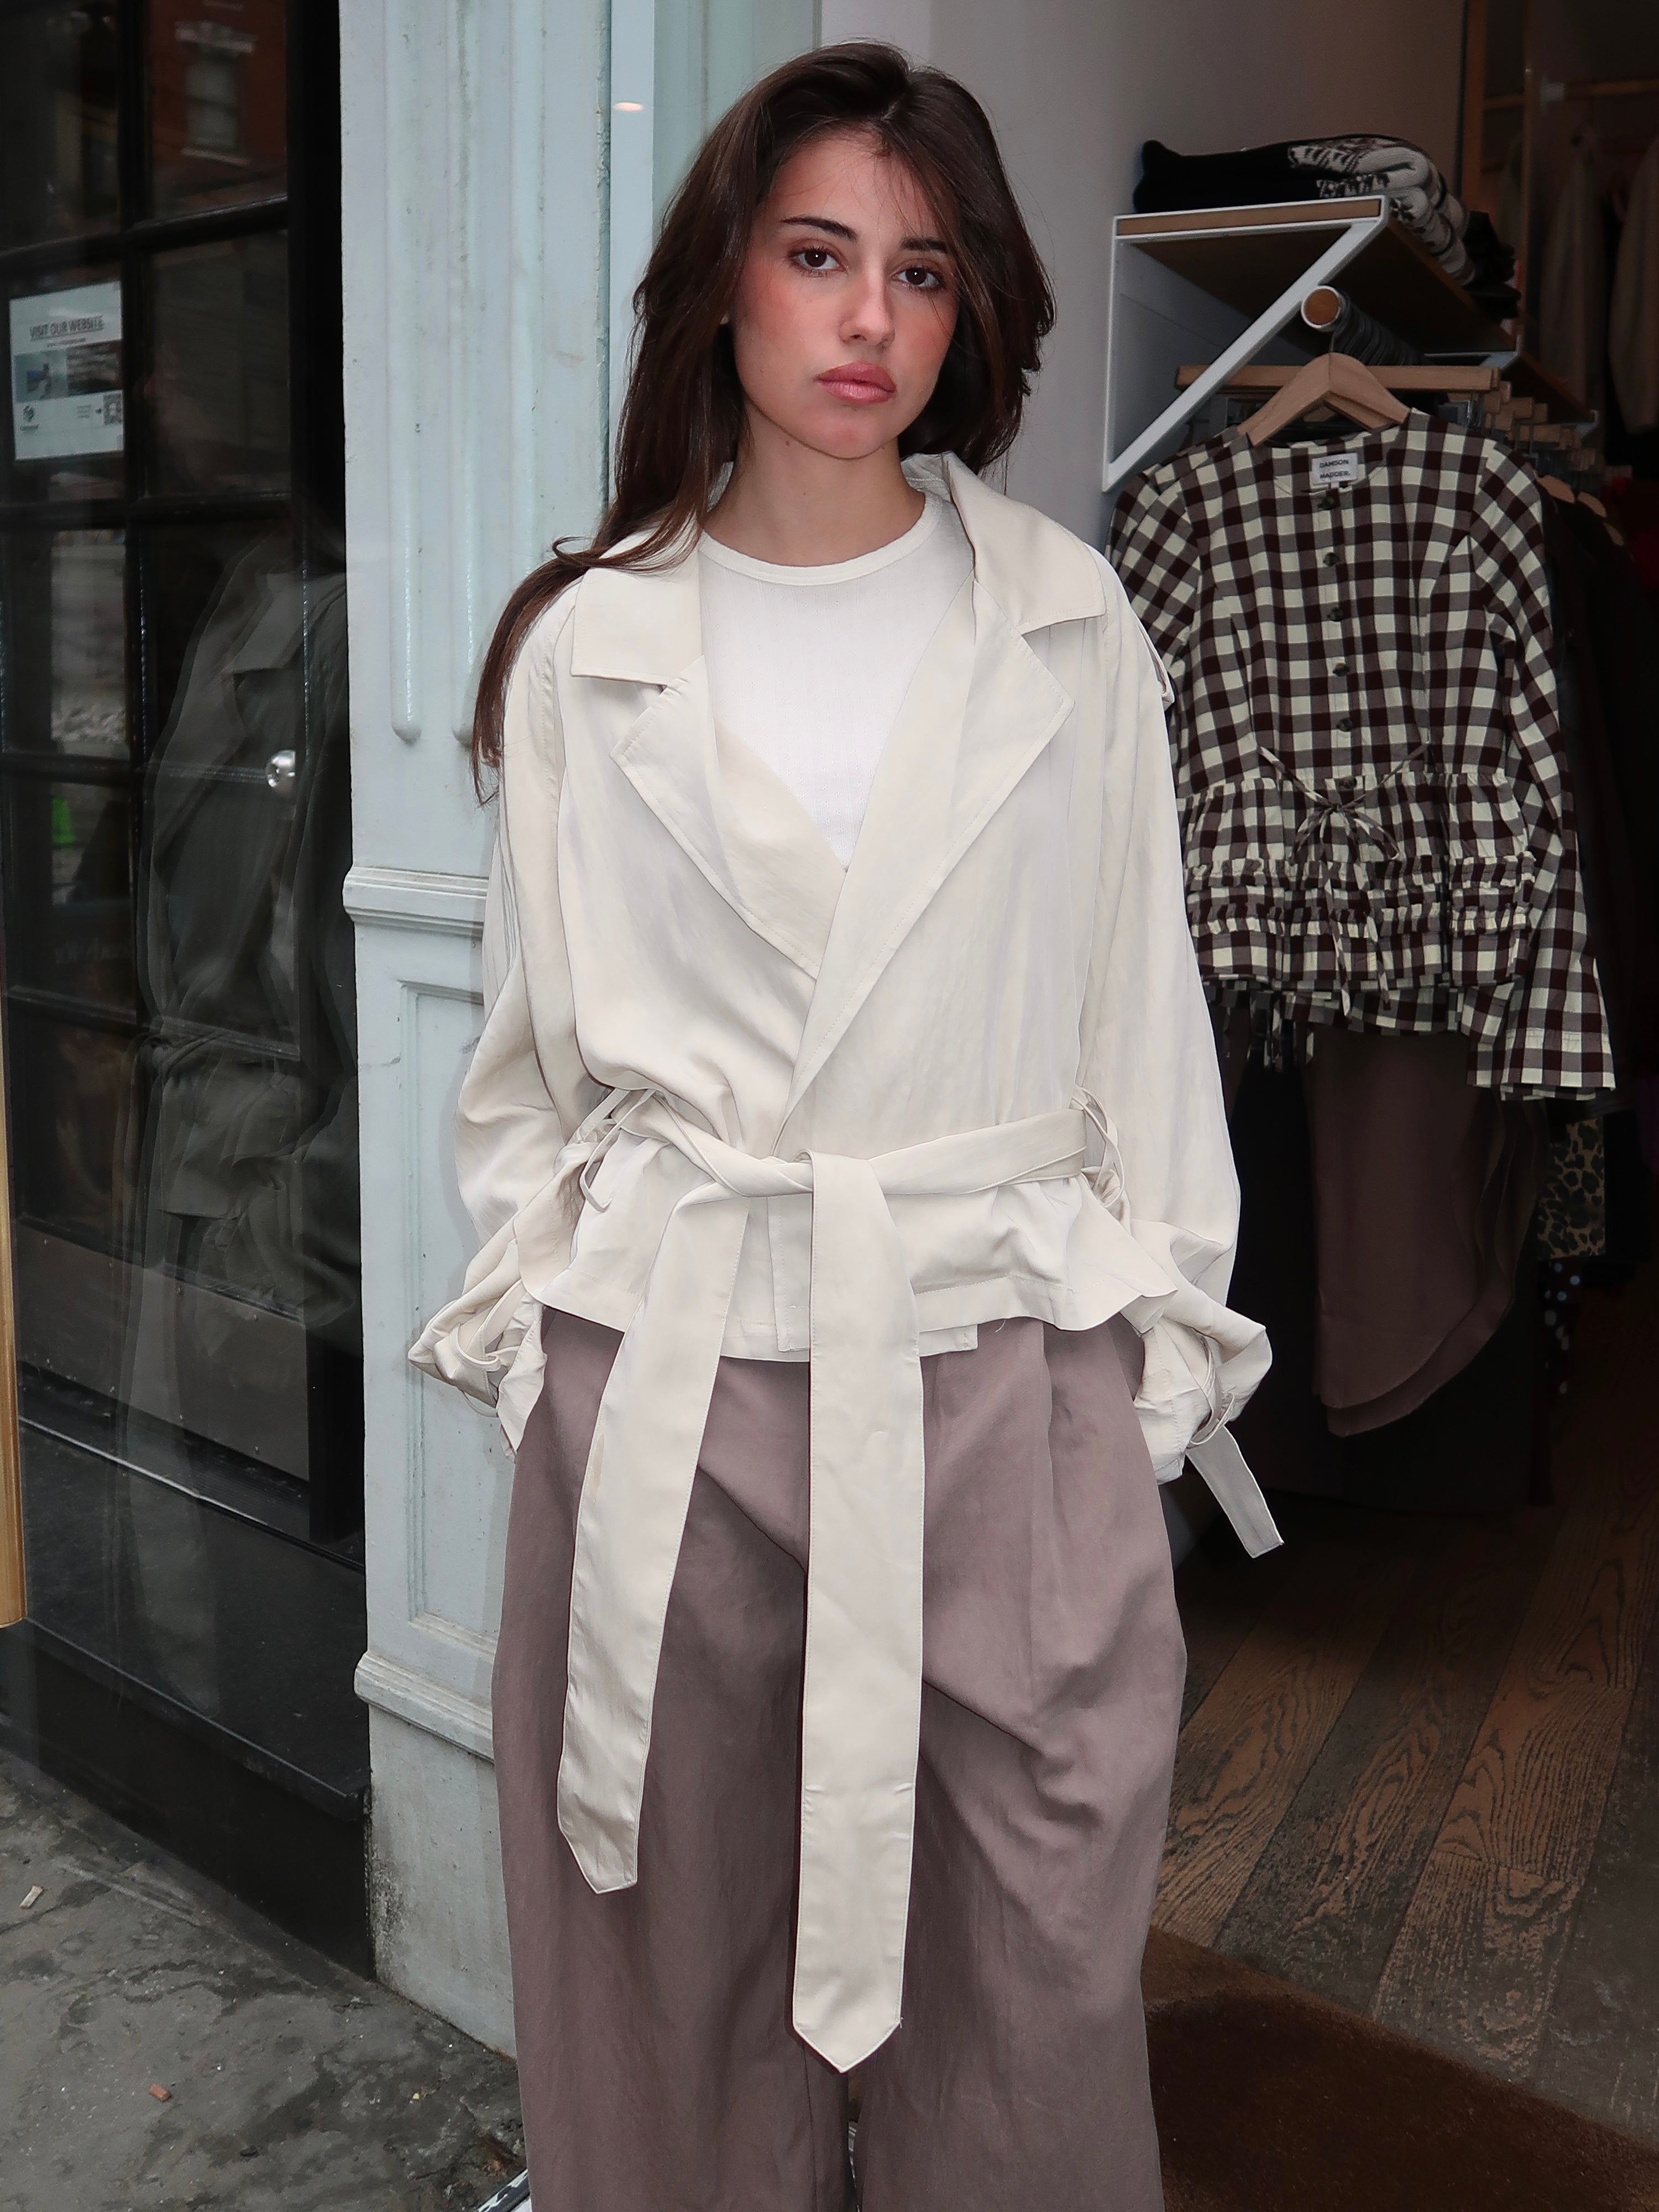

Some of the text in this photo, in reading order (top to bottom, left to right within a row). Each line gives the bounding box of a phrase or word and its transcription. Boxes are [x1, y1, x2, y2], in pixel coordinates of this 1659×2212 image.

[29, 315, 104, 338] VISIT OUR WEBSITE
[1319, 459, 1349, 468] DAMSON
